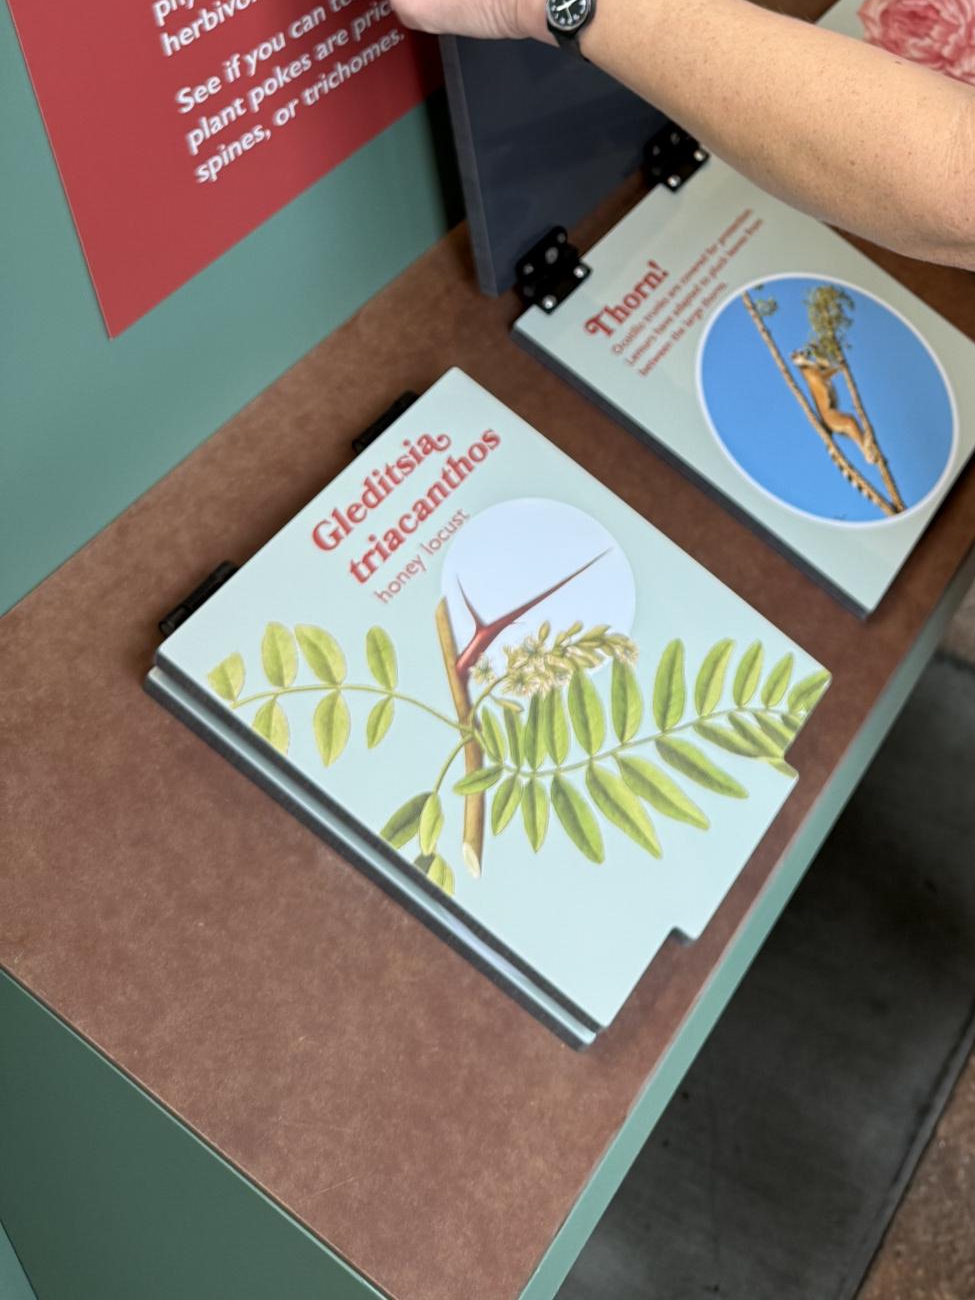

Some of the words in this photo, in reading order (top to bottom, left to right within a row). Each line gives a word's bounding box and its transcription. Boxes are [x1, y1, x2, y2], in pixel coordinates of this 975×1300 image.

[175, 77, 222, 114] See
[224, 54, 242, 83] if
[244, 32, 287, 76] you
[289, 6, 327, 40] can
[186, 99, 248, 156] plant
[249, 54, 312, 113] pokes
[314, 28, 350, 62] are
[195, 122, 272, 183] spines,
[273, 99, 301, 126] or
[301, 27, 405, 106] trichomes.
[584, 260, 670, 337] Thorn!
[311, 432, 452, 551] Gleditsia
[348, 428, 501, 584] triacanthos
[373, 554, 427, 604] honey
[420, 508, 471, 555] locust
